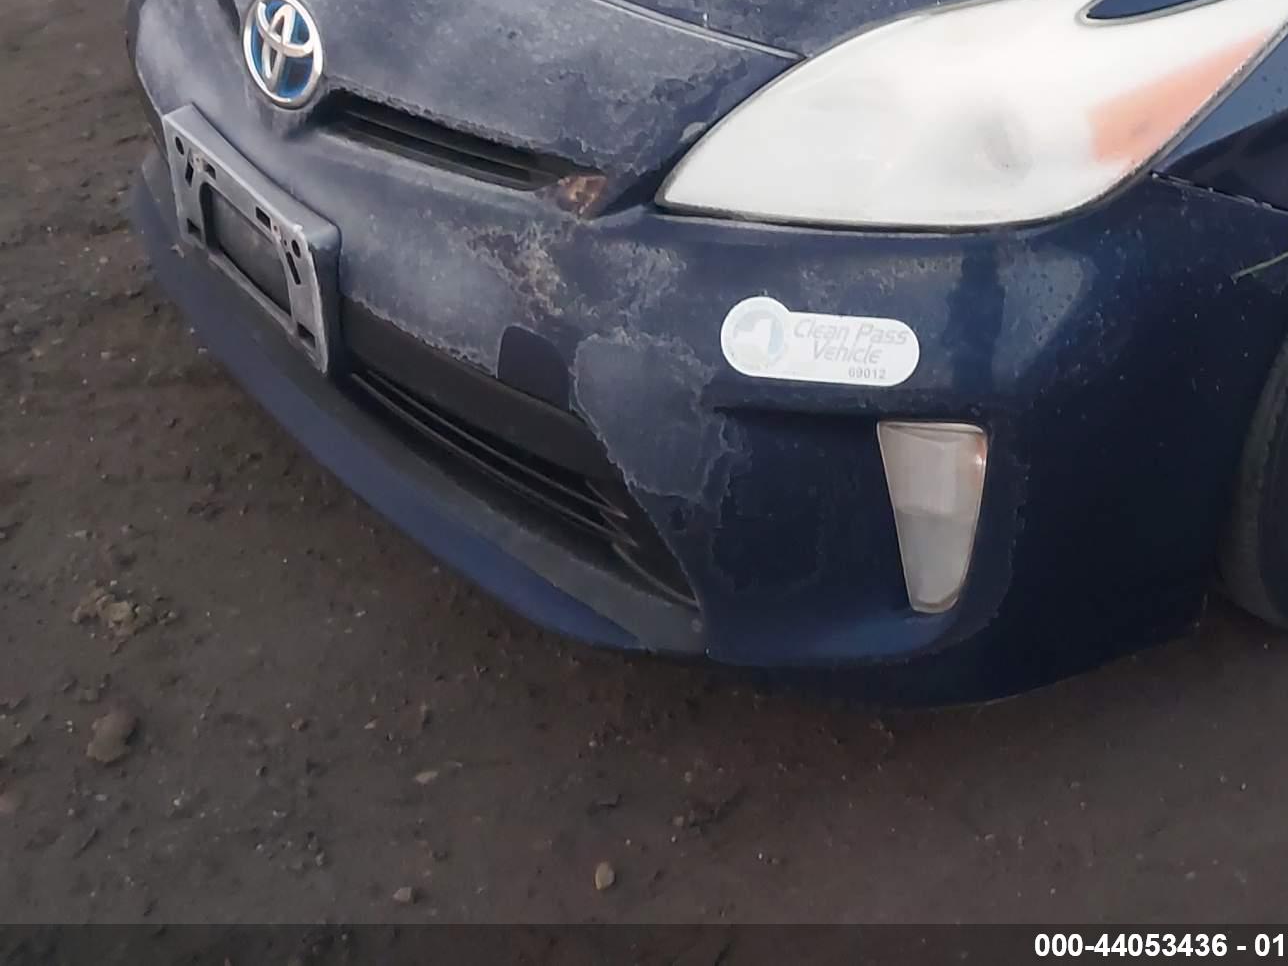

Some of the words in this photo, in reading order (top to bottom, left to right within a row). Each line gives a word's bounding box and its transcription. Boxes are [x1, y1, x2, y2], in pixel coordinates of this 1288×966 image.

[794, 317, 851, 342] Clean
[858, 323, 911, 346] Pass
[812, 339, 883, 365] Vehicle
